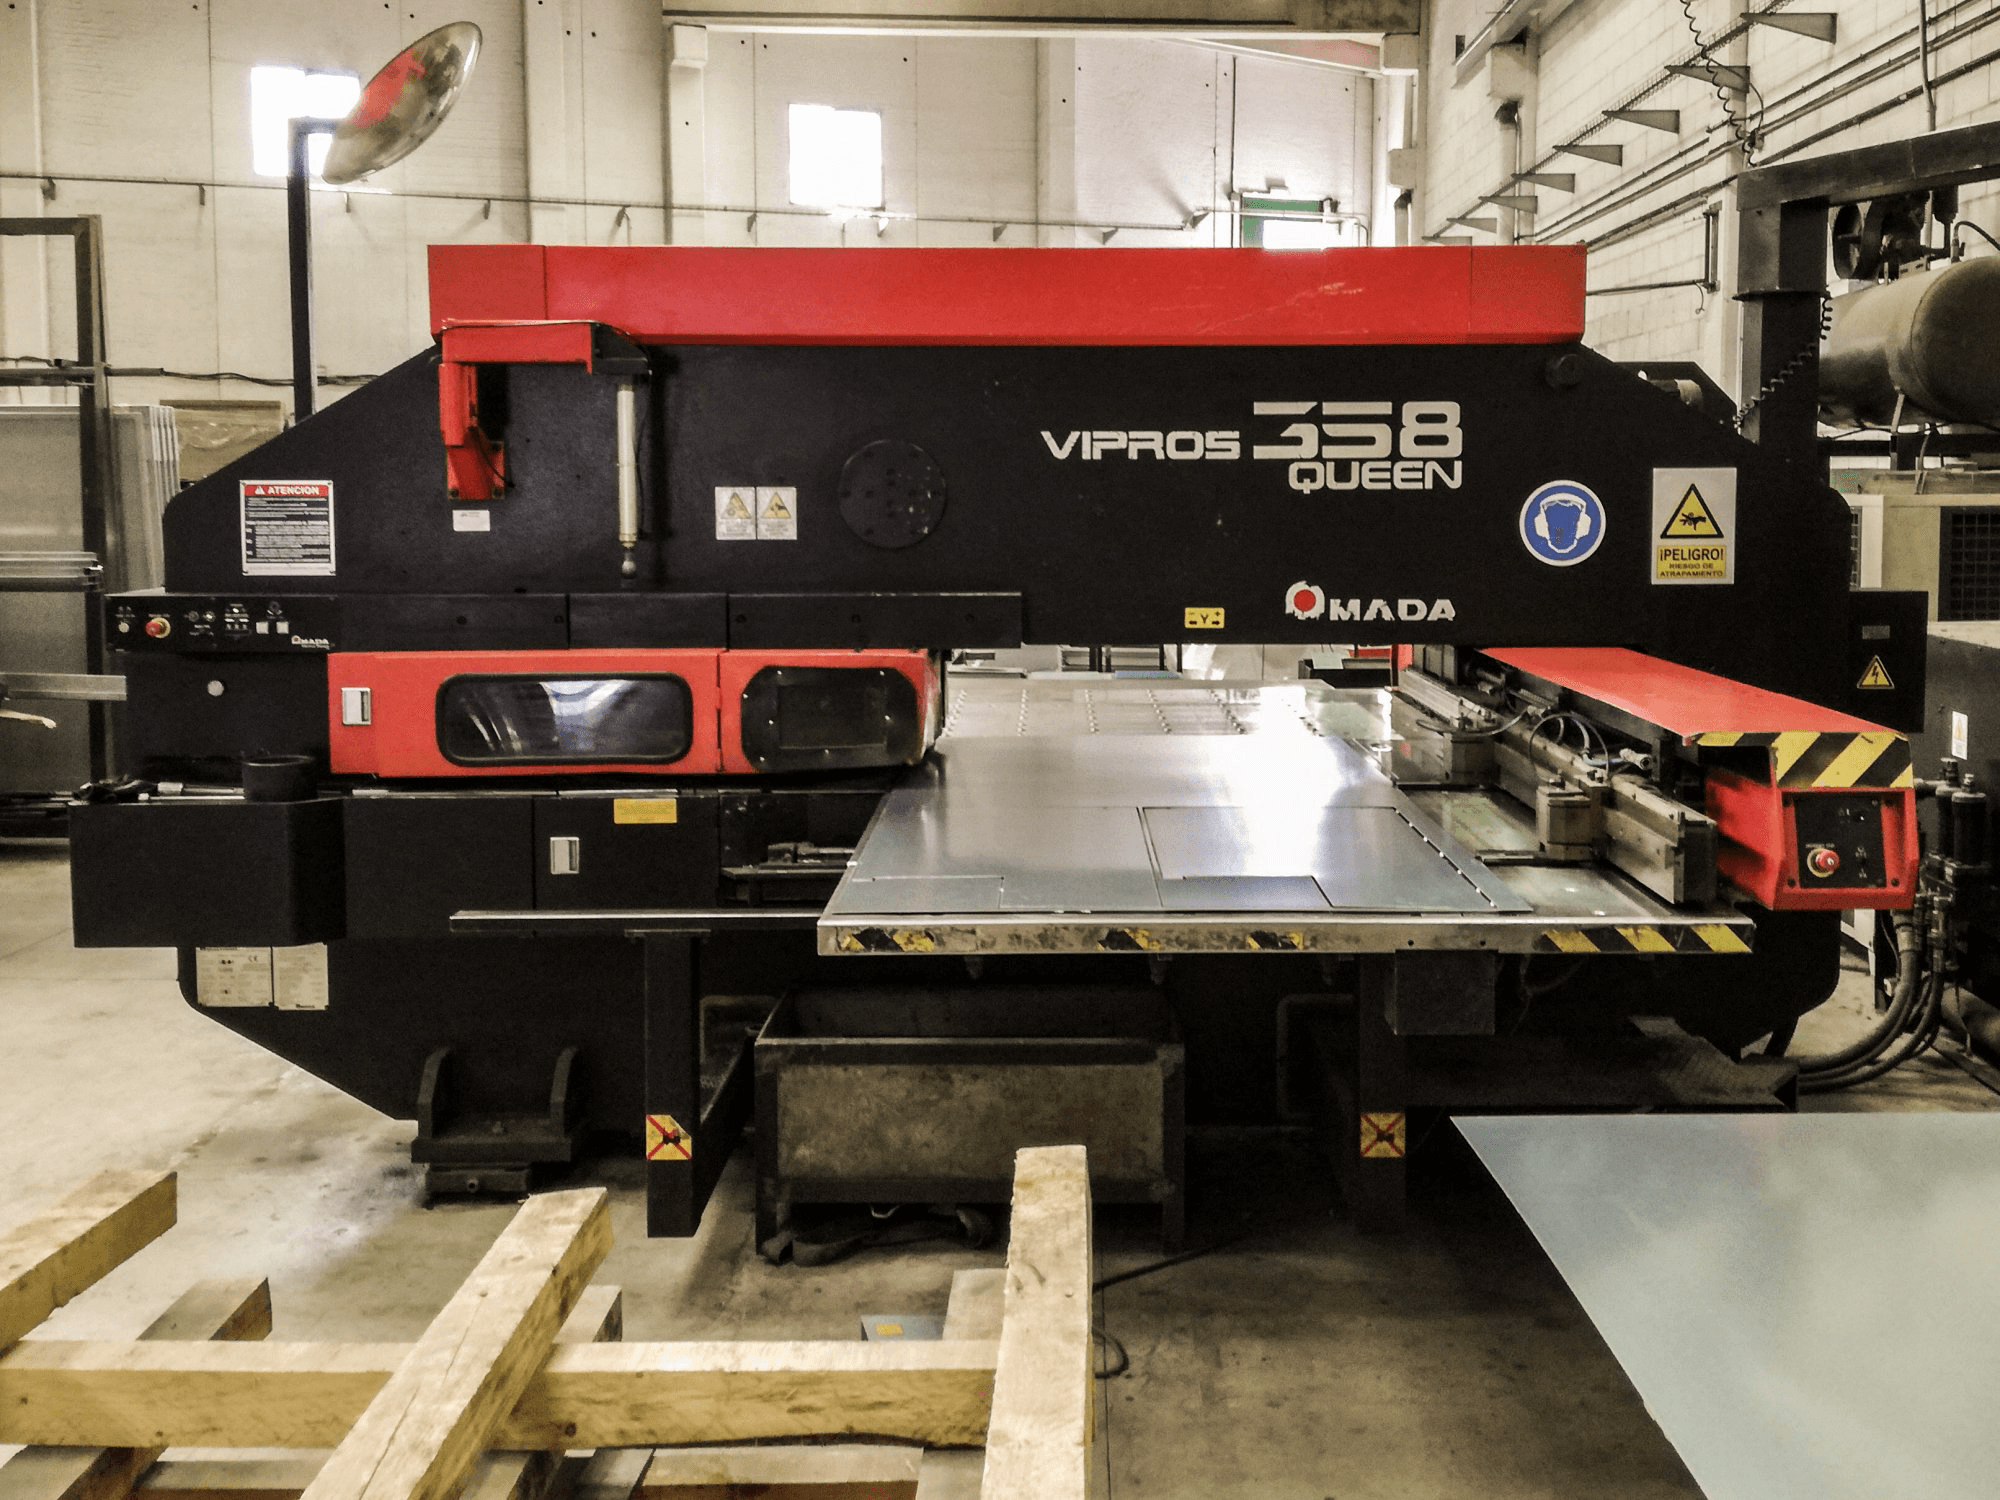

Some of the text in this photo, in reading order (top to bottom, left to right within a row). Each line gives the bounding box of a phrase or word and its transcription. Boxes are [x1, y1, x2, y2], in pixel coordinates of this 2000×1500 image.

[1040, 401, 1463, 460] VIPROS 358
[1288, 460, 1463, 494] QUEEN
[268, 486, 320, 495] ATENCION
[1660, 548, 1724, 561] ¡PELIGRO!
